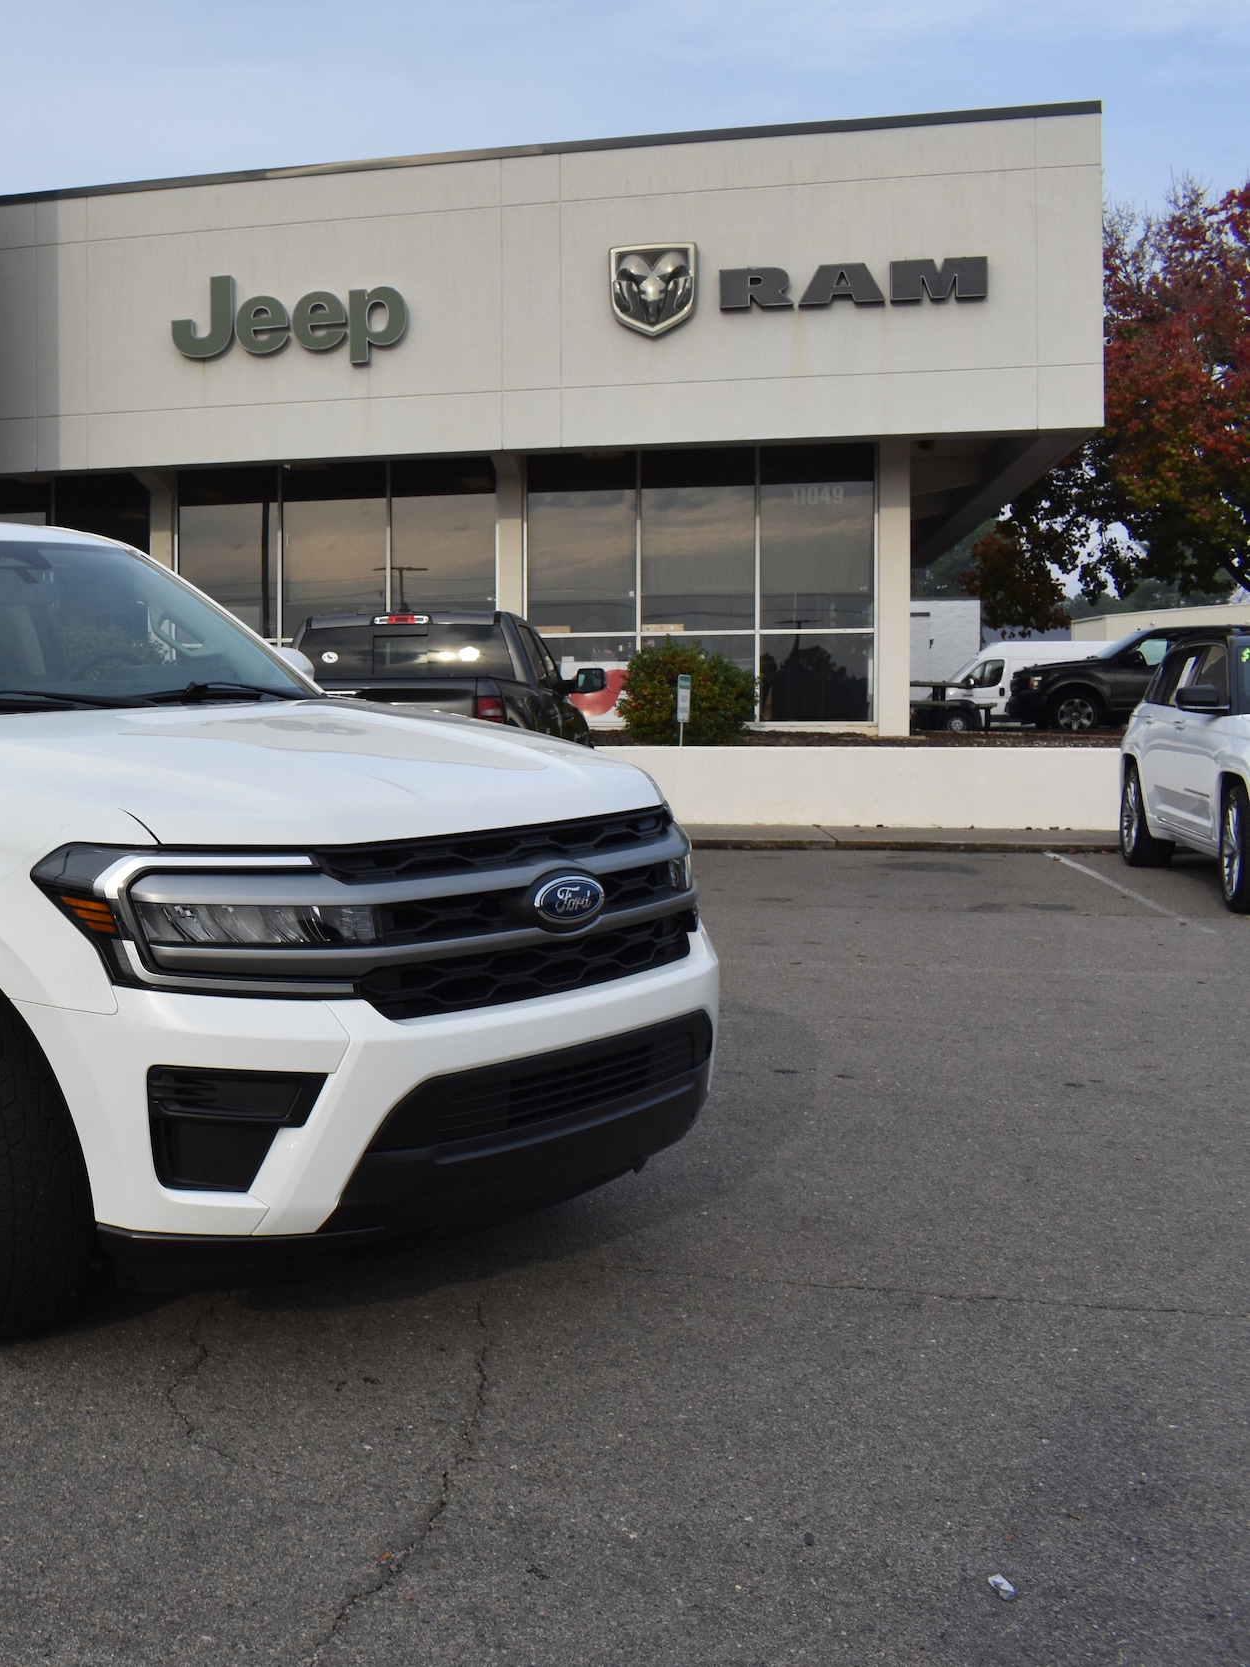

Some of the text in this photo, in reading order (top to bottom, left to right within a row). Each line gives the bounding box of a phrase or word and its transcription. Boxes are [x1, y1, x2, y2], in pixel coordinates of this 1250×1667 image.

[719, 256, 988, 311] RAM
[171, 275, 409, 367] Jeep
[555, 886, 591, 913] Ford
